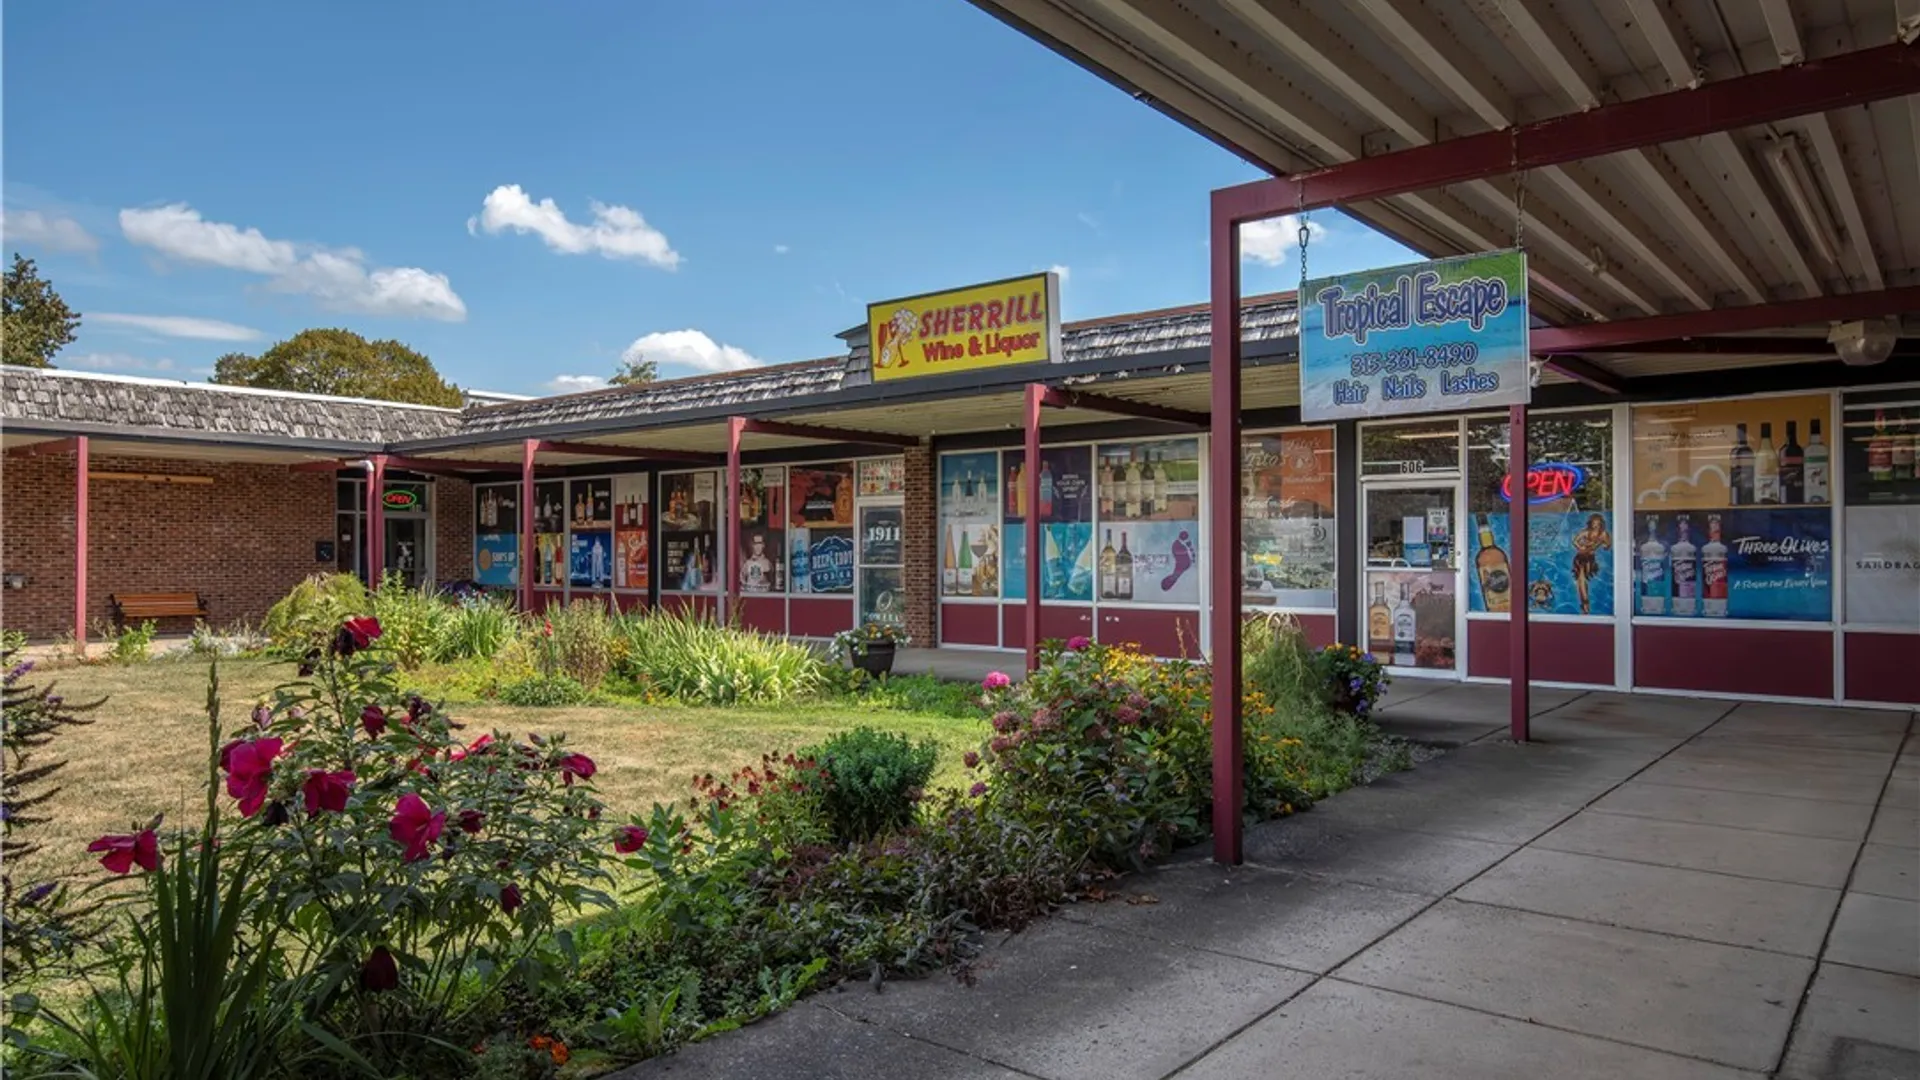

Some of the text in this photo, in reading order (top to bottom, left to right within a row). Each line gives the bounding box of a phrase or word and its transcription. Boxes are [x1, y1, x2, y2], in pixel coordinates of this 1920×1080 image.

[919, 291, 1044, 338] SHERRILL
[1318, 271, 1507, 344] Tropical Escape
[922, 331, 1041, 362] Wine & Liquor
[1333, 367, 1499, 405] Hair Nails Lashes
[1401, 461, 1424, 474] 606
[386, 494, 411, 504] OPEN
[868, 526, 900, 541] 1911
